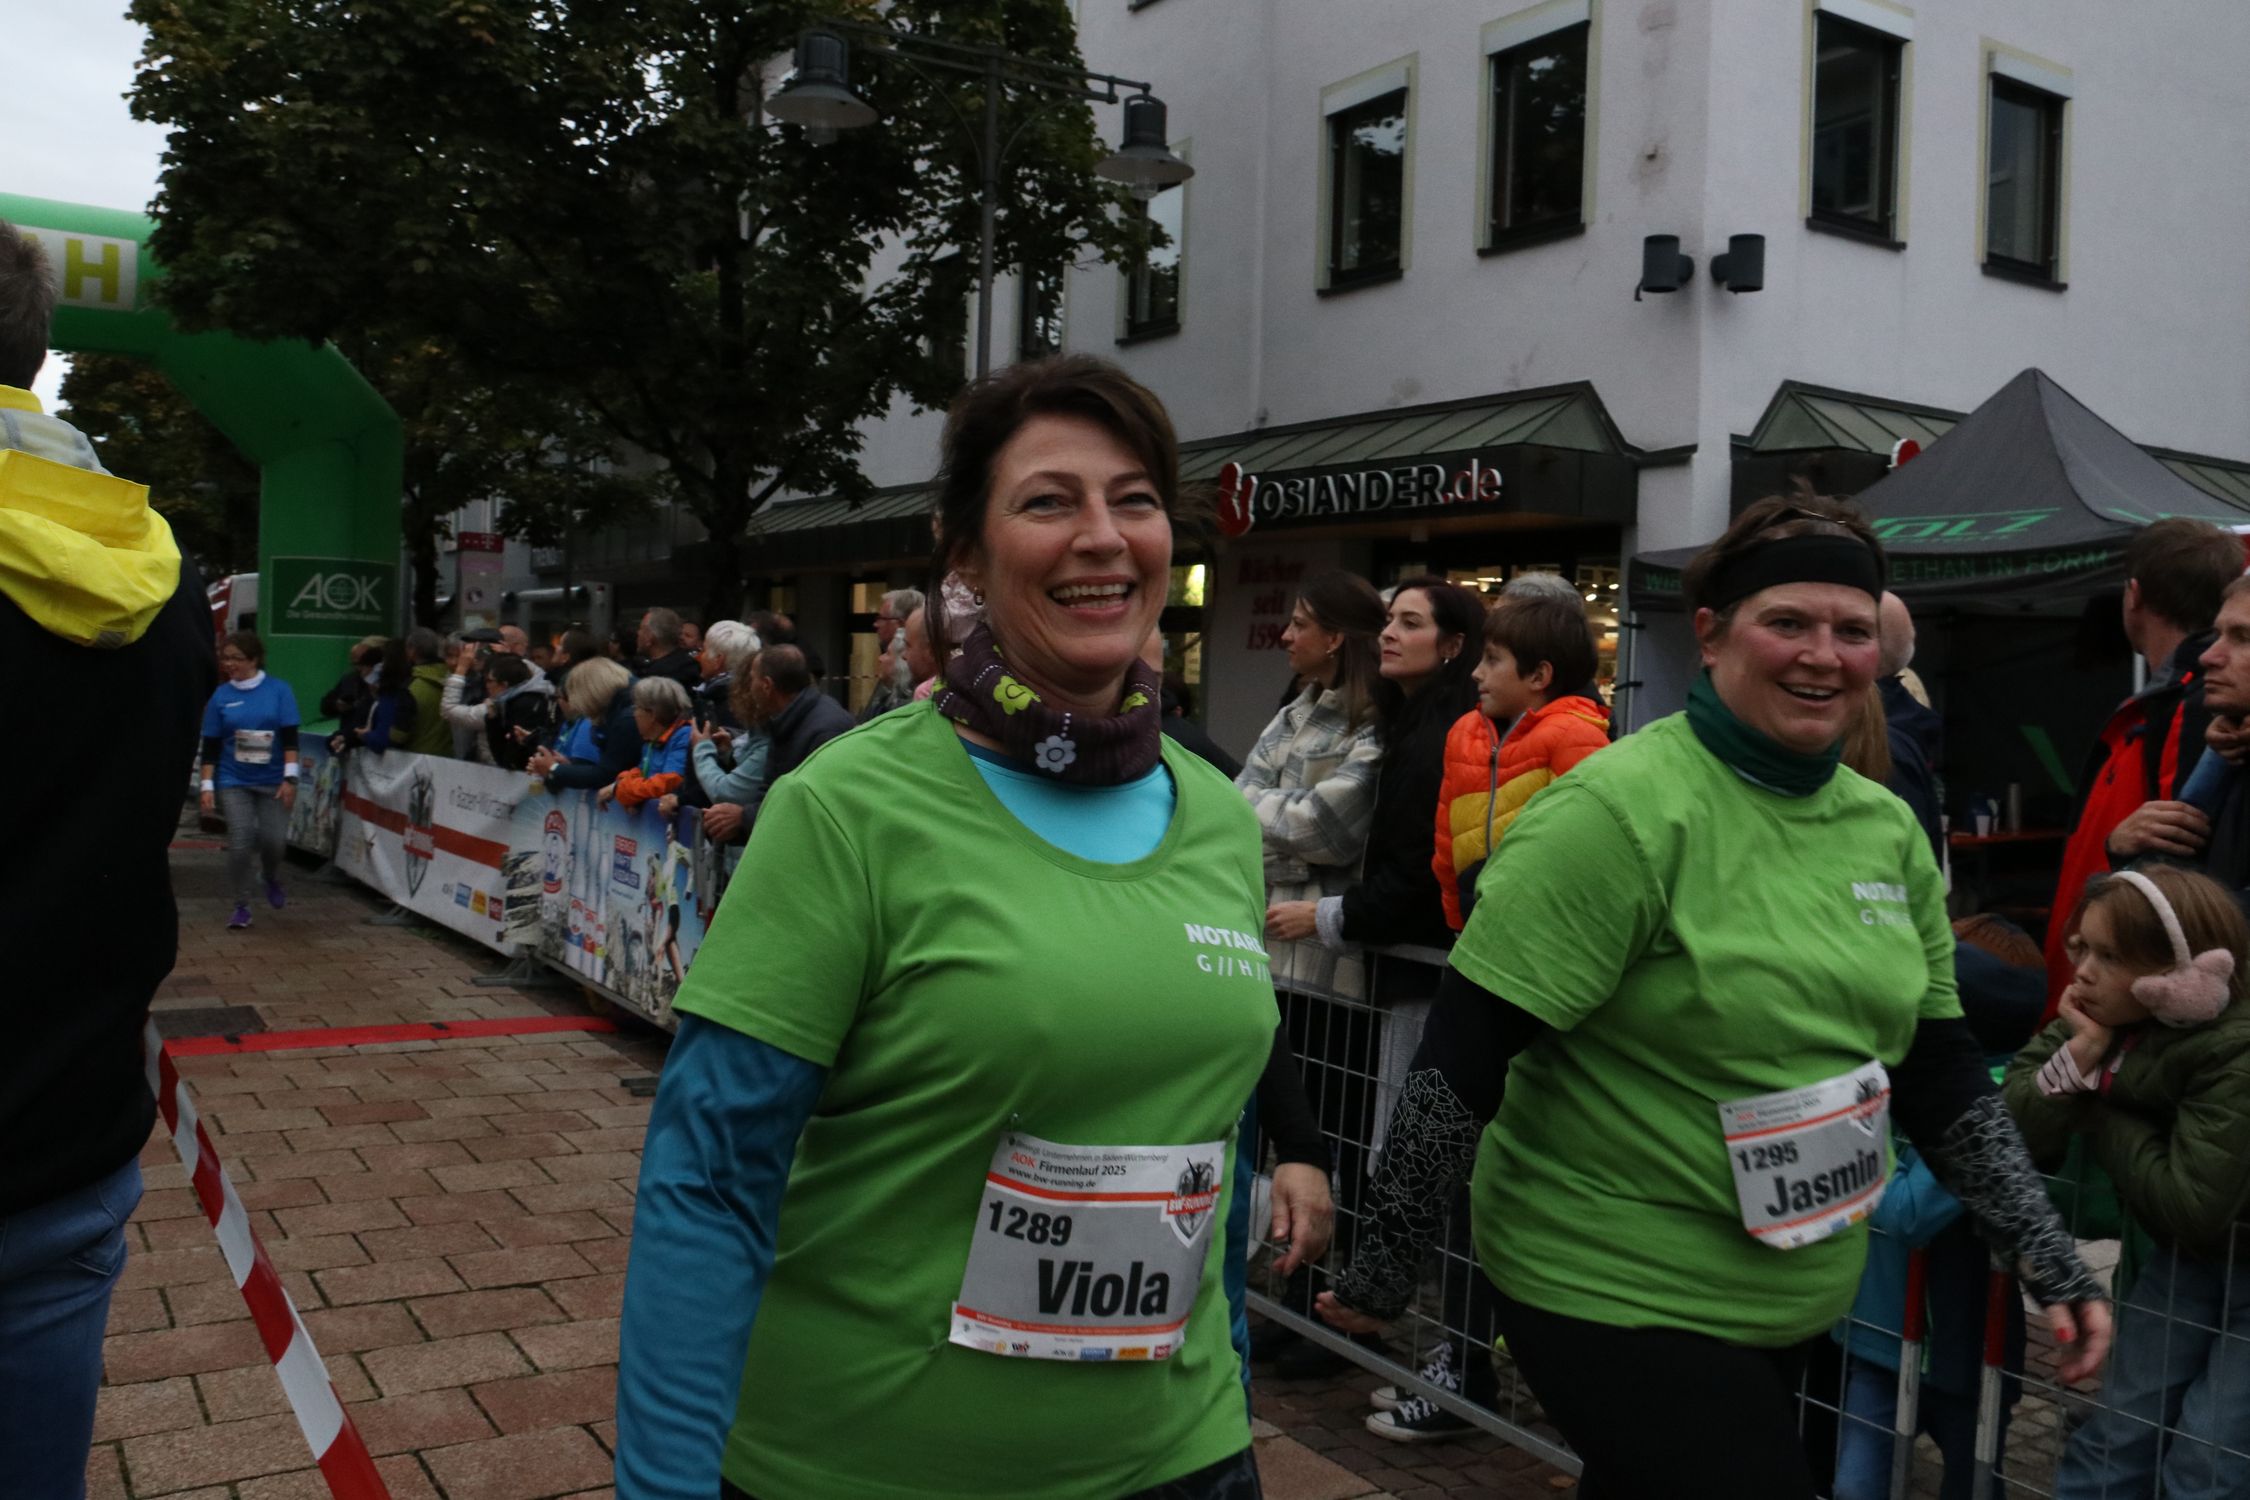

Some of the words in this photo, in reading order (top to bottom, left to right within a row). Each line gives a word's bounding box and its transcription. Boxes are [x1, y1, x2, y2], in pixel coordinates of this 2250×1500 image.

[1260, 458, 1503, 520] OSIANDER.de
[1891, 557, 1975, 581] ETHAN
[1988, 556, 2013, 577] IN
[2024, 549, 2107, 575] FORM
[289, 572, 382, 611] AOK
[1252, 589, 1286, 615] seit
[1011, 1152, 1036, 1168] AOK
[1040, 1160, 1099, 1176] Firmenlauf
[1102, 1164, 1126, 1176] 2025
[1737, 1140, 1799, 1172] 1295
[1008, 1167, 1096, 1189] www.bw-running.de
[1765, 1149, 1878, 1216] Jasmin
[989, 1200, 1072, 1246] 1289
[1038, 1258, 1169, 1316] Viola
